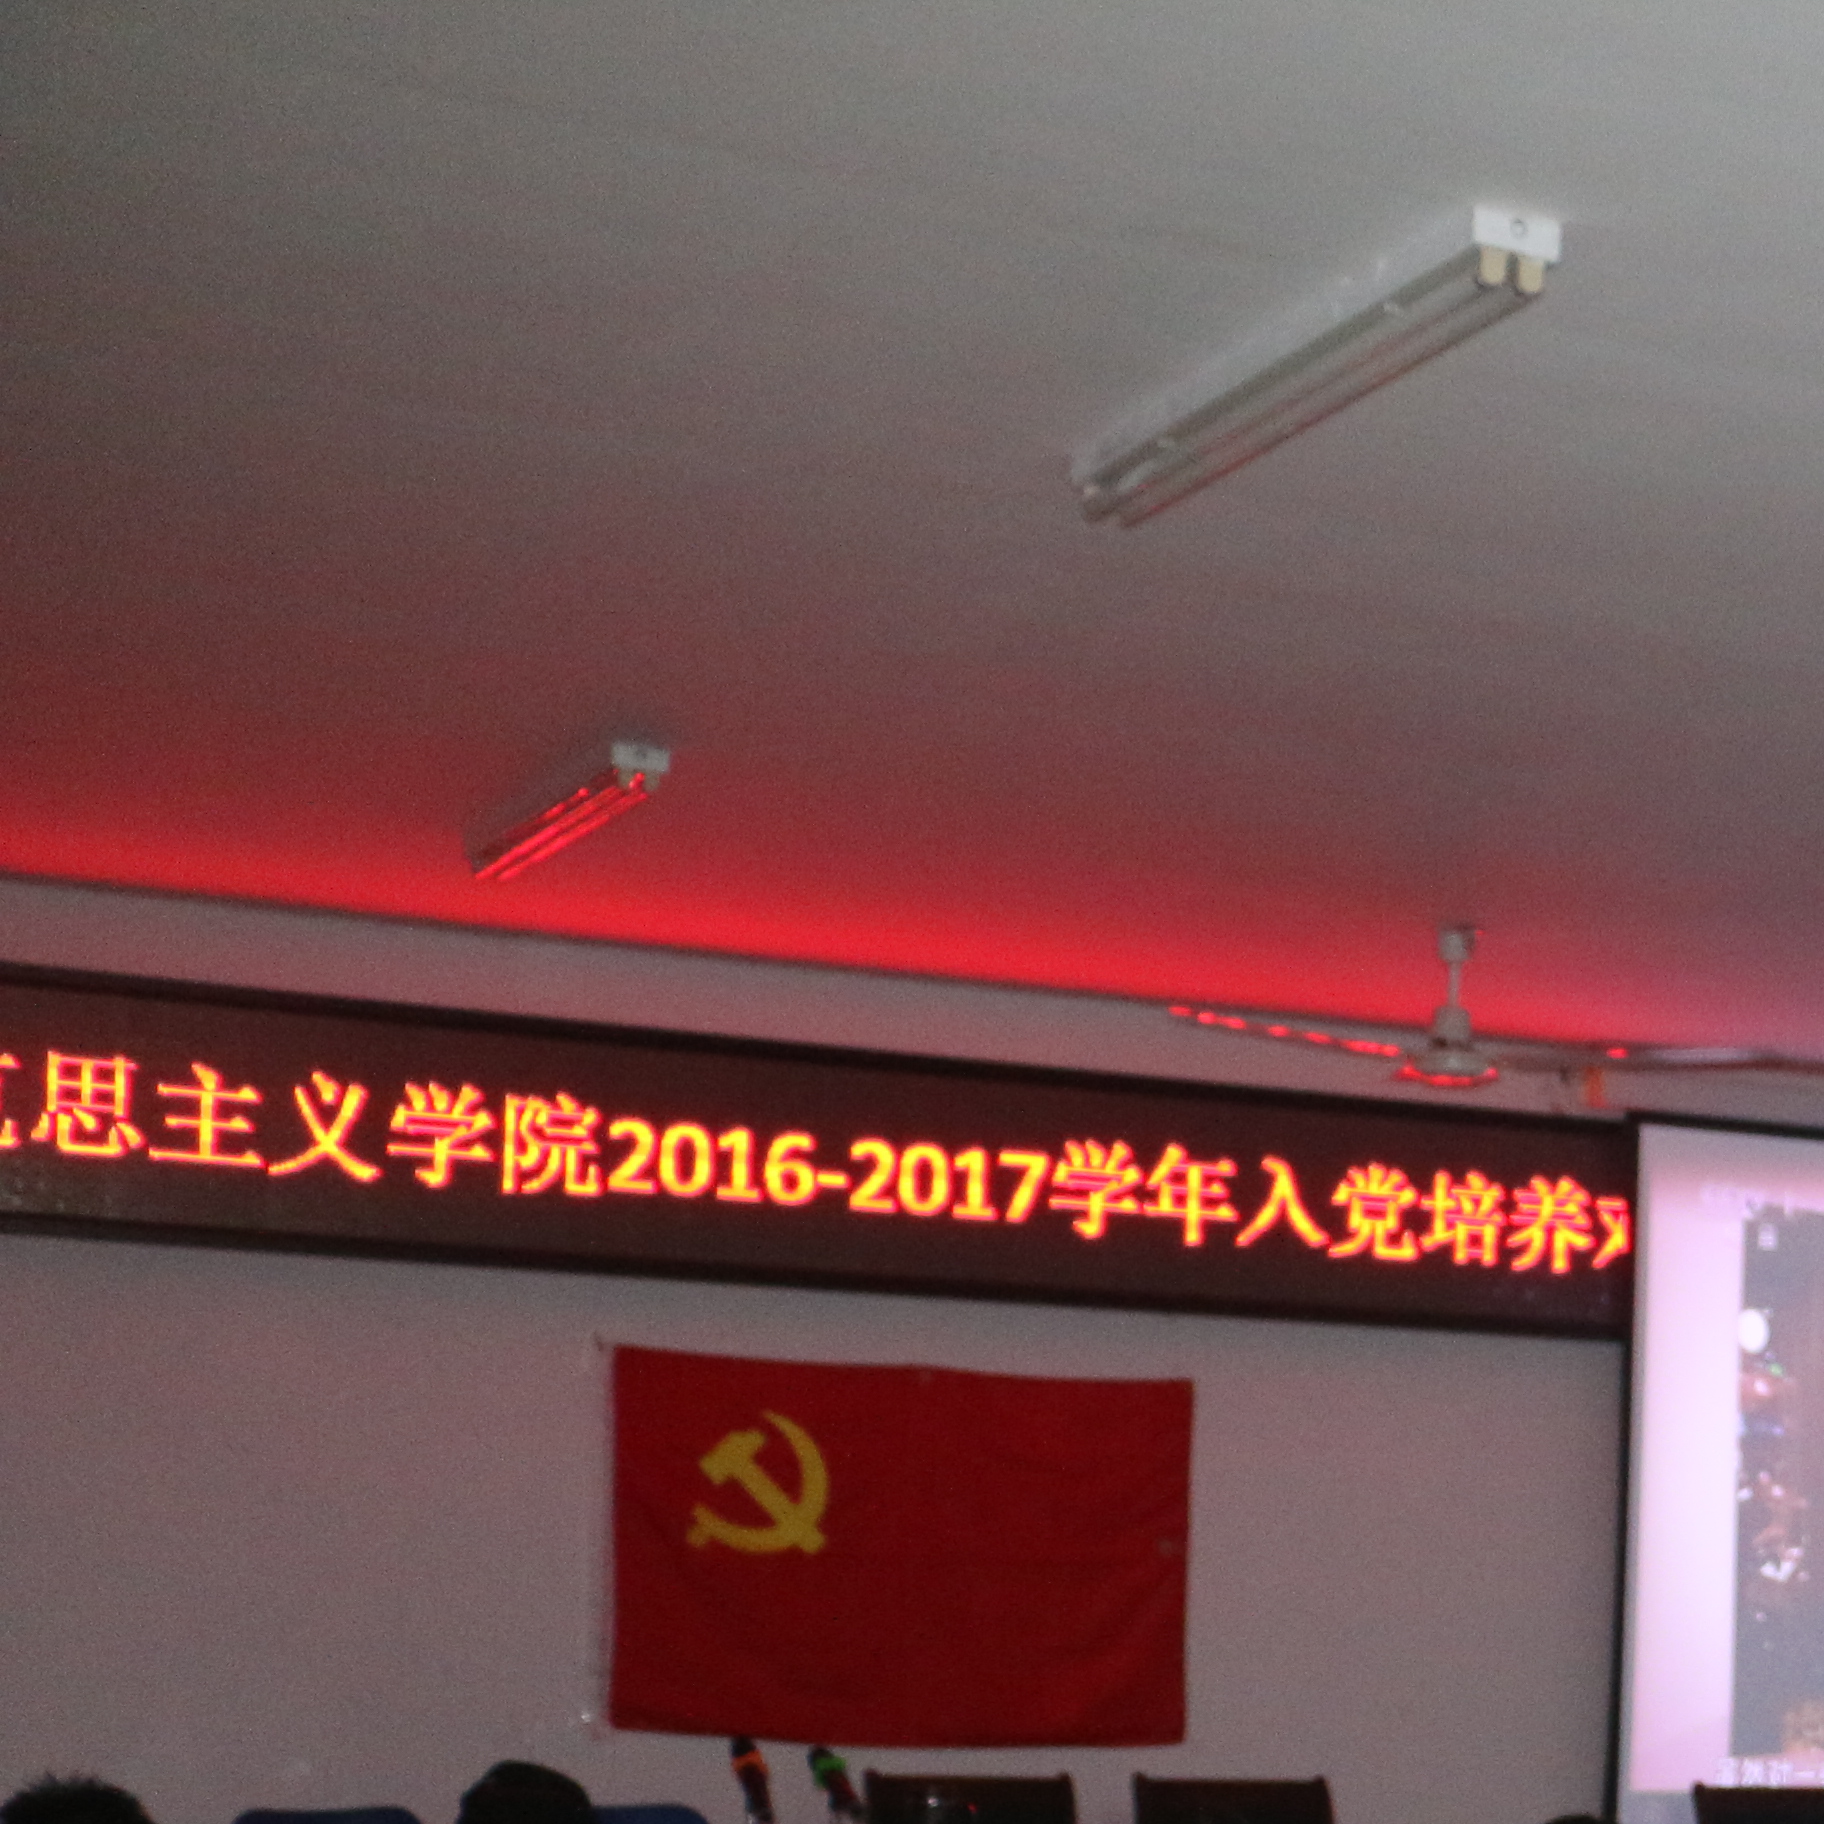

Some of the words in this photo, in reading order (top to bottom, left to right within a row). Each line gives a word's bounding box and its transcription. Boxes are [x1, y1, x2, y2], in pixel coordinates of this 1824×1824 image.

[0, 1050, 1631, 1275] 思主义学院2016-2017学年入党培养
